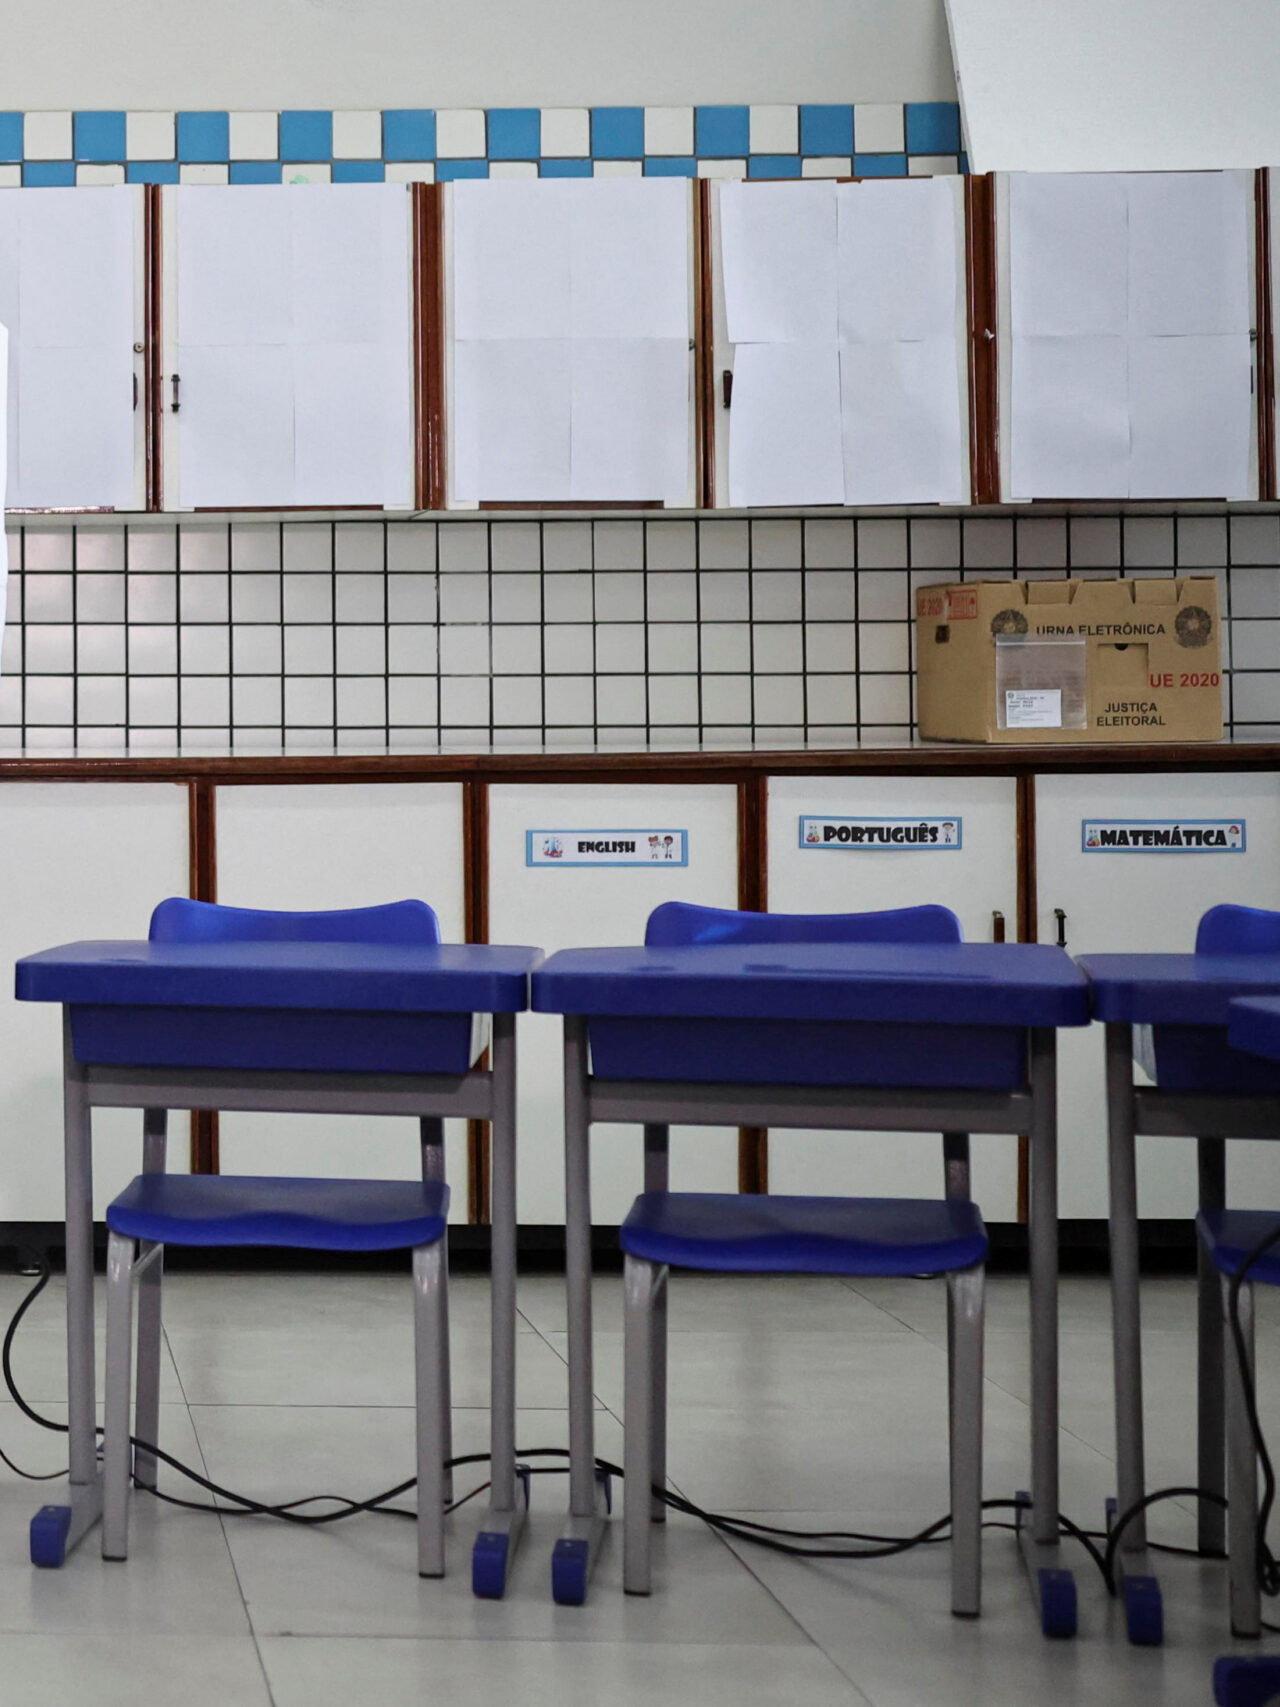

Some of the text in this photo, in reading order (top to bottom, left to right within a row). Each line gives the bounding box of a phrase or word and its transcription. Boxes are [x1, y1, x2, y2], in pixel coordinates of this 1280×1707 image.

[1036, 622, 1166, 636] URNA ELETRÔNICA
[1150, 672, 1220, 688] UE 2020
[1104, 702, 1158, 714] JUSTIÇA
[1096, 715, 1166, 727] ELEITORAL
[823, 822, 939, 843] PORTUGUÊS
[1100, 825, 1227, 846] MATEMÁTICA
[577, 841, 636, 853] ENGLISH
